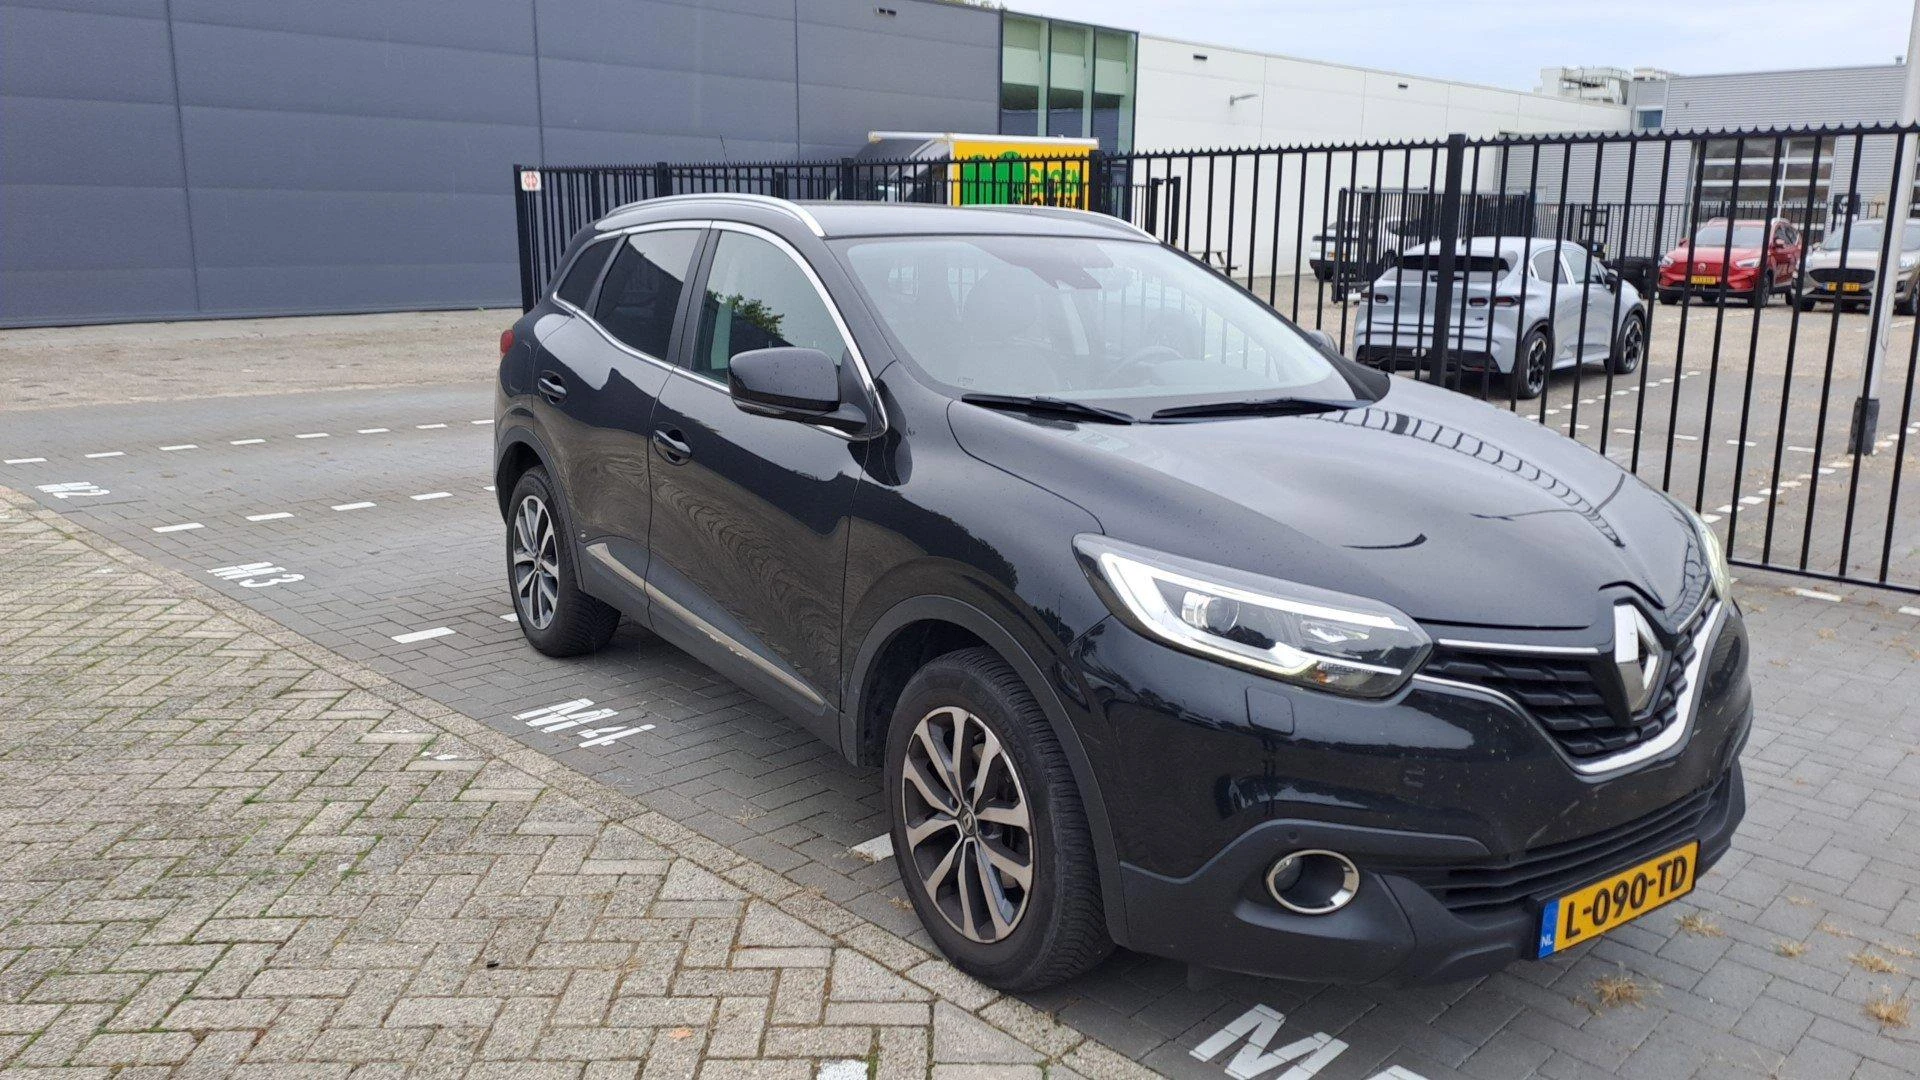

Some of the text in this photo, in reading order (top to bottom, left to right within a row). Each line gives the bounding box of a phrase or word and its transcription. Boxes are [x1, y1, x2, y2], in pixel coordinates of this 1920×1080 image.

[206, 561, 305, 588] M3
[512, 698, 657, 748] M4
[1565, 856, 1687, 939] L-090-TD
[1540, 935, 1554, 948] NL
[1189, 1003, 1430, 1080] M
